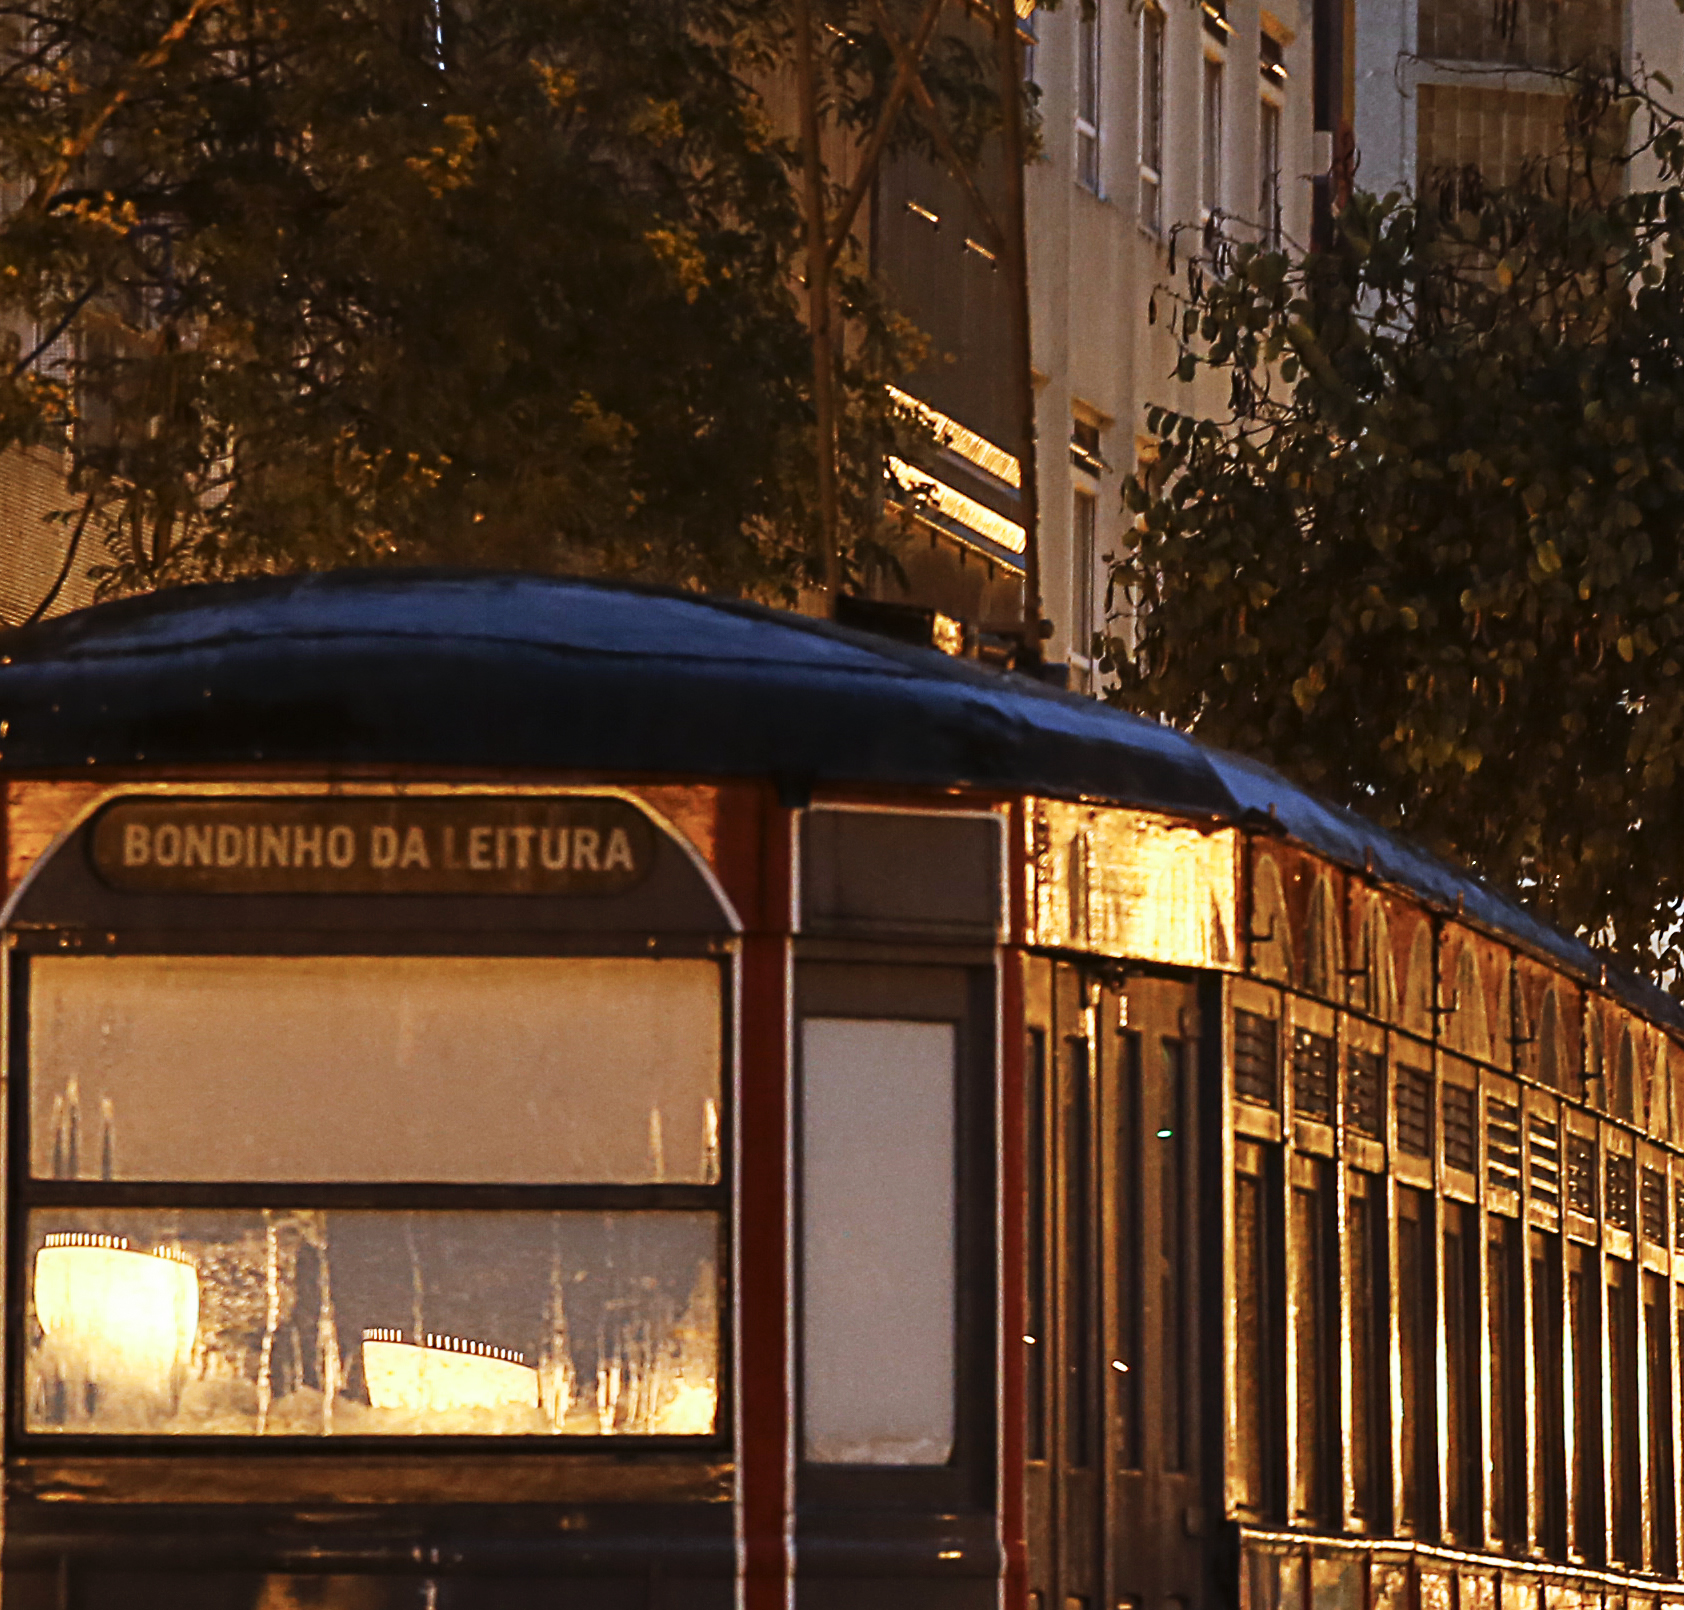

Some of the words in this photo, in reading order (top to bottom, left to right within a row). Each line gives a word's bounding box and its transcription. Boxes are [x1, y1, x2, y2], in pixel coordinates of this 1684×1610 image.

[123, 824, 356, 868] BONDINHO
[370, 825, 431, 868] DA
[441, 825, 635, 871] LEITURA
